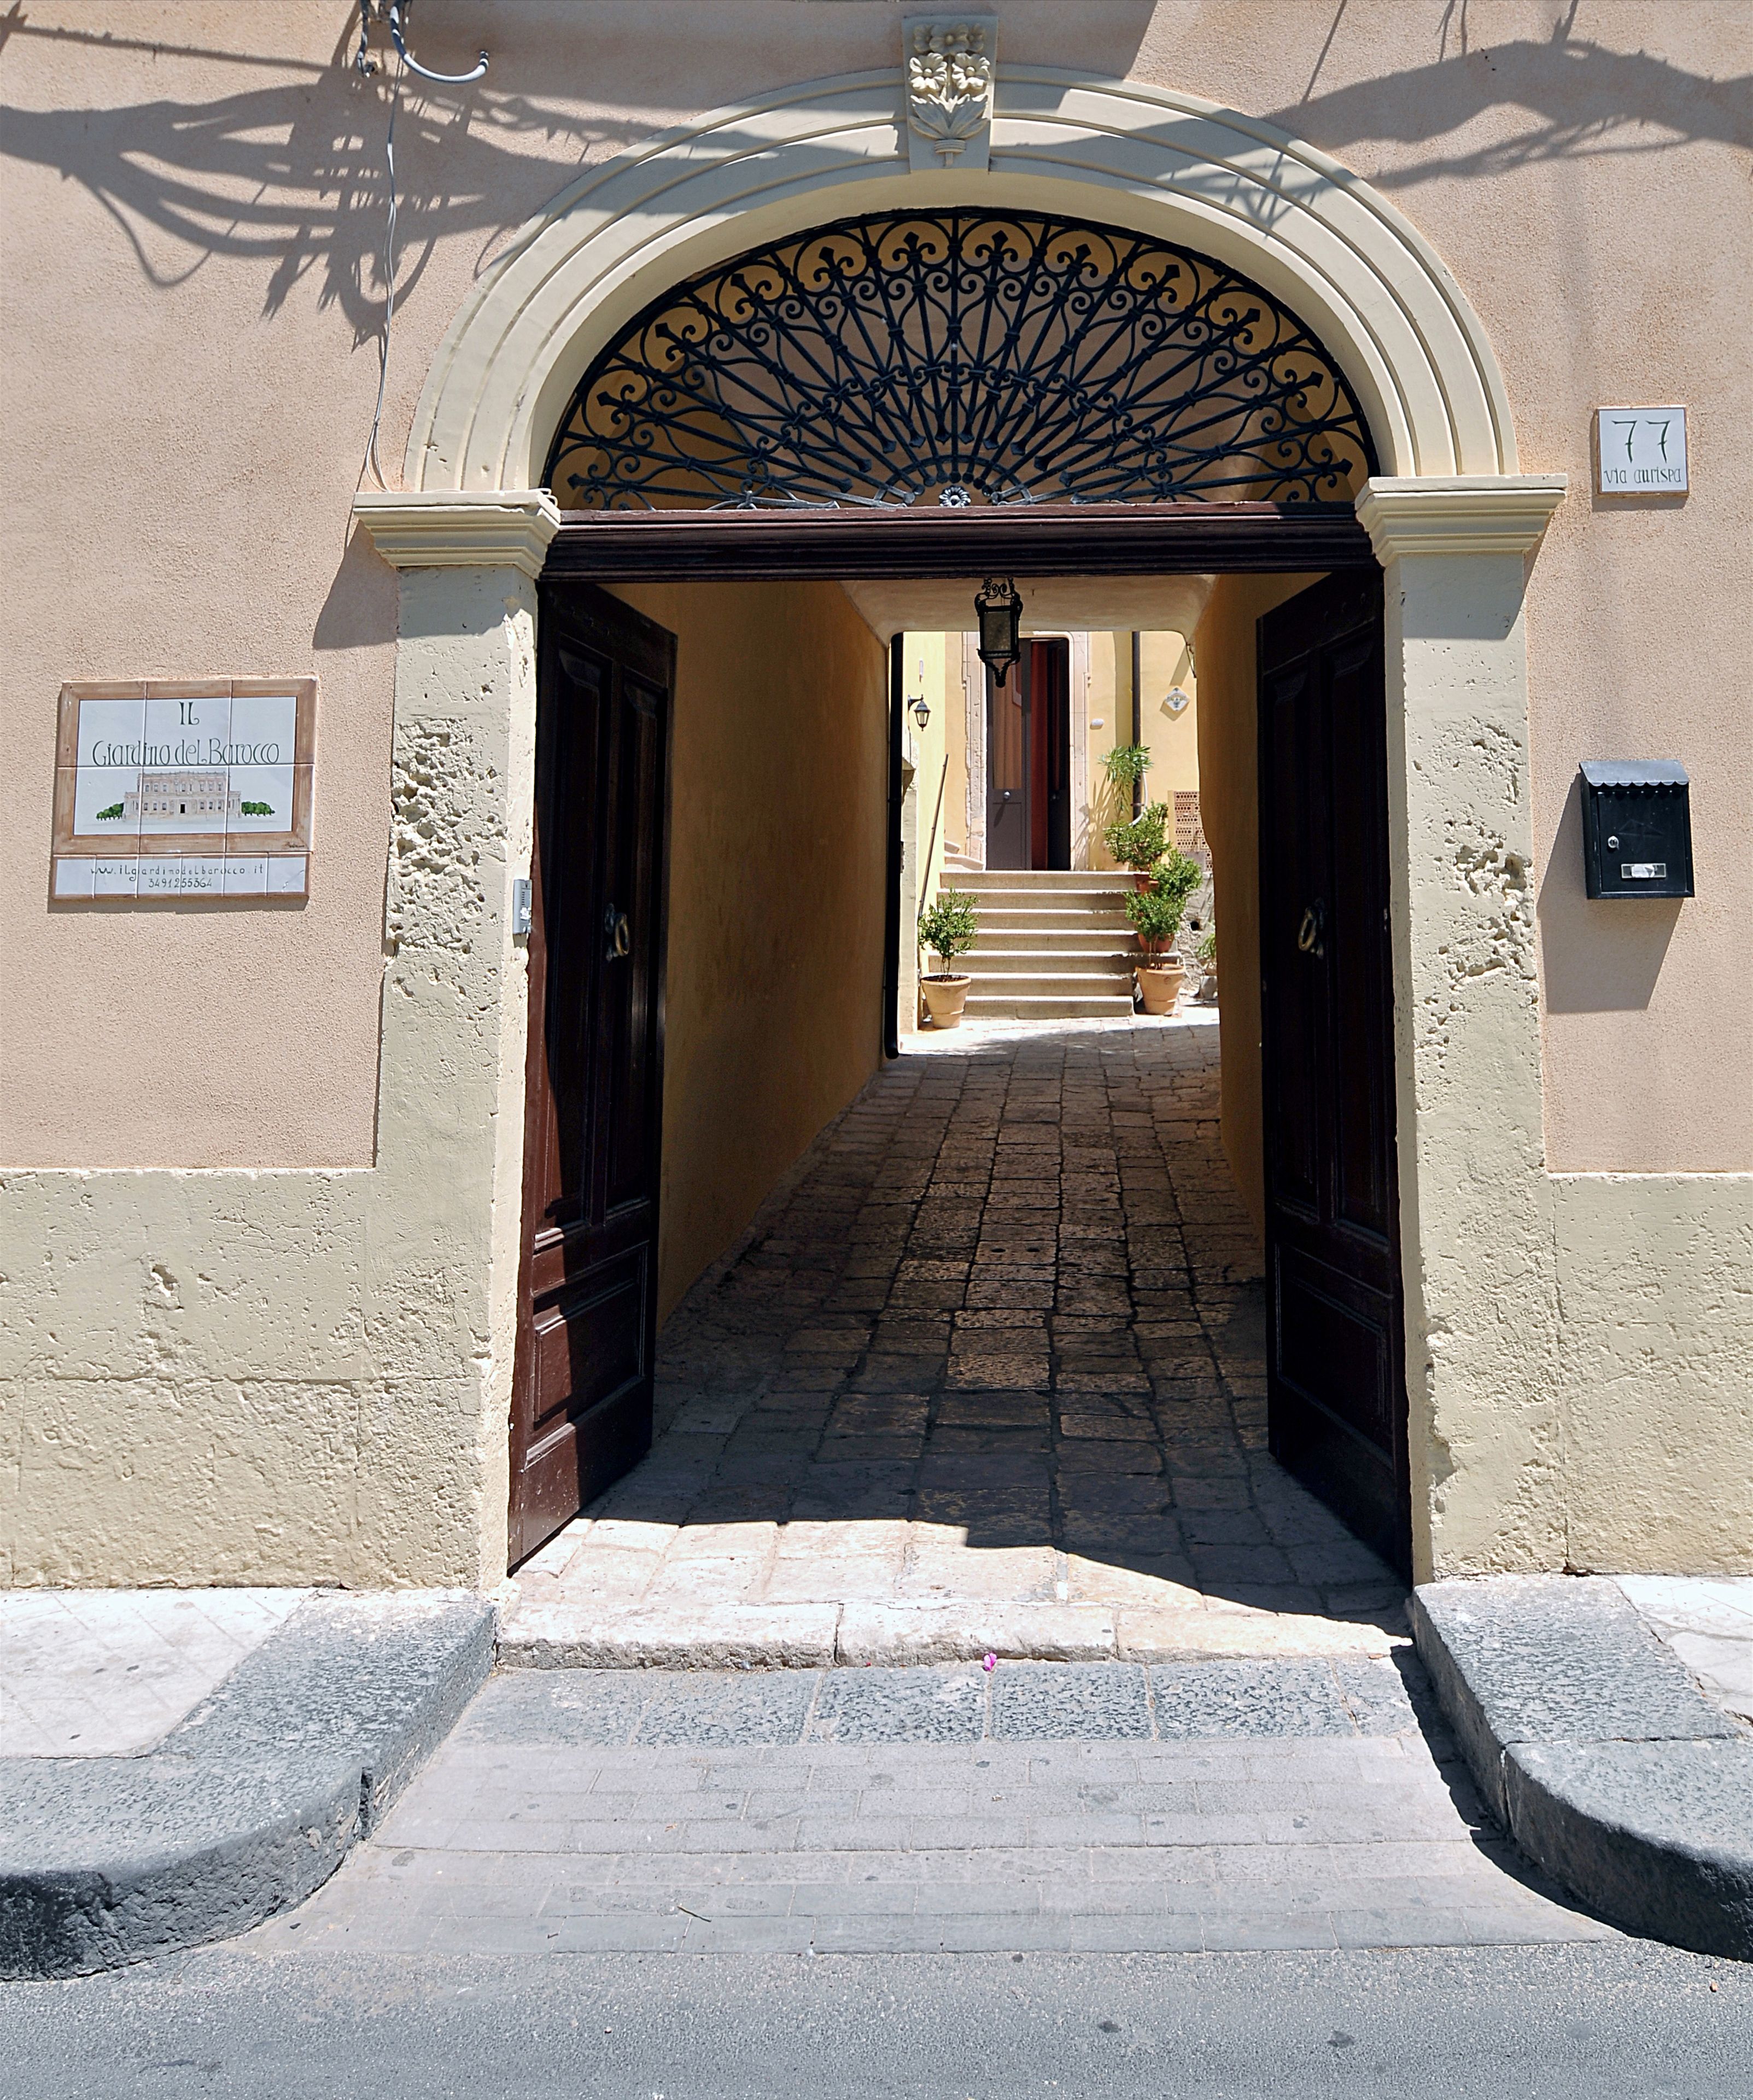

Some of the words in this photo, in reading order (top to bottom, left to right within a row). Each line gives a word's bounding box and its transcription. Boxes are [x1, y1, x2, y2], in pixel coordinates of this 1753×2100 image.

[1611, 420, 1671, 464] 77
[1604, 468, 1627, 484] via
[1633, 466, 1682, 484] aurispa
[92, 739, 171, 766] Giardino
[208, 737, 279, 766] Barocco
